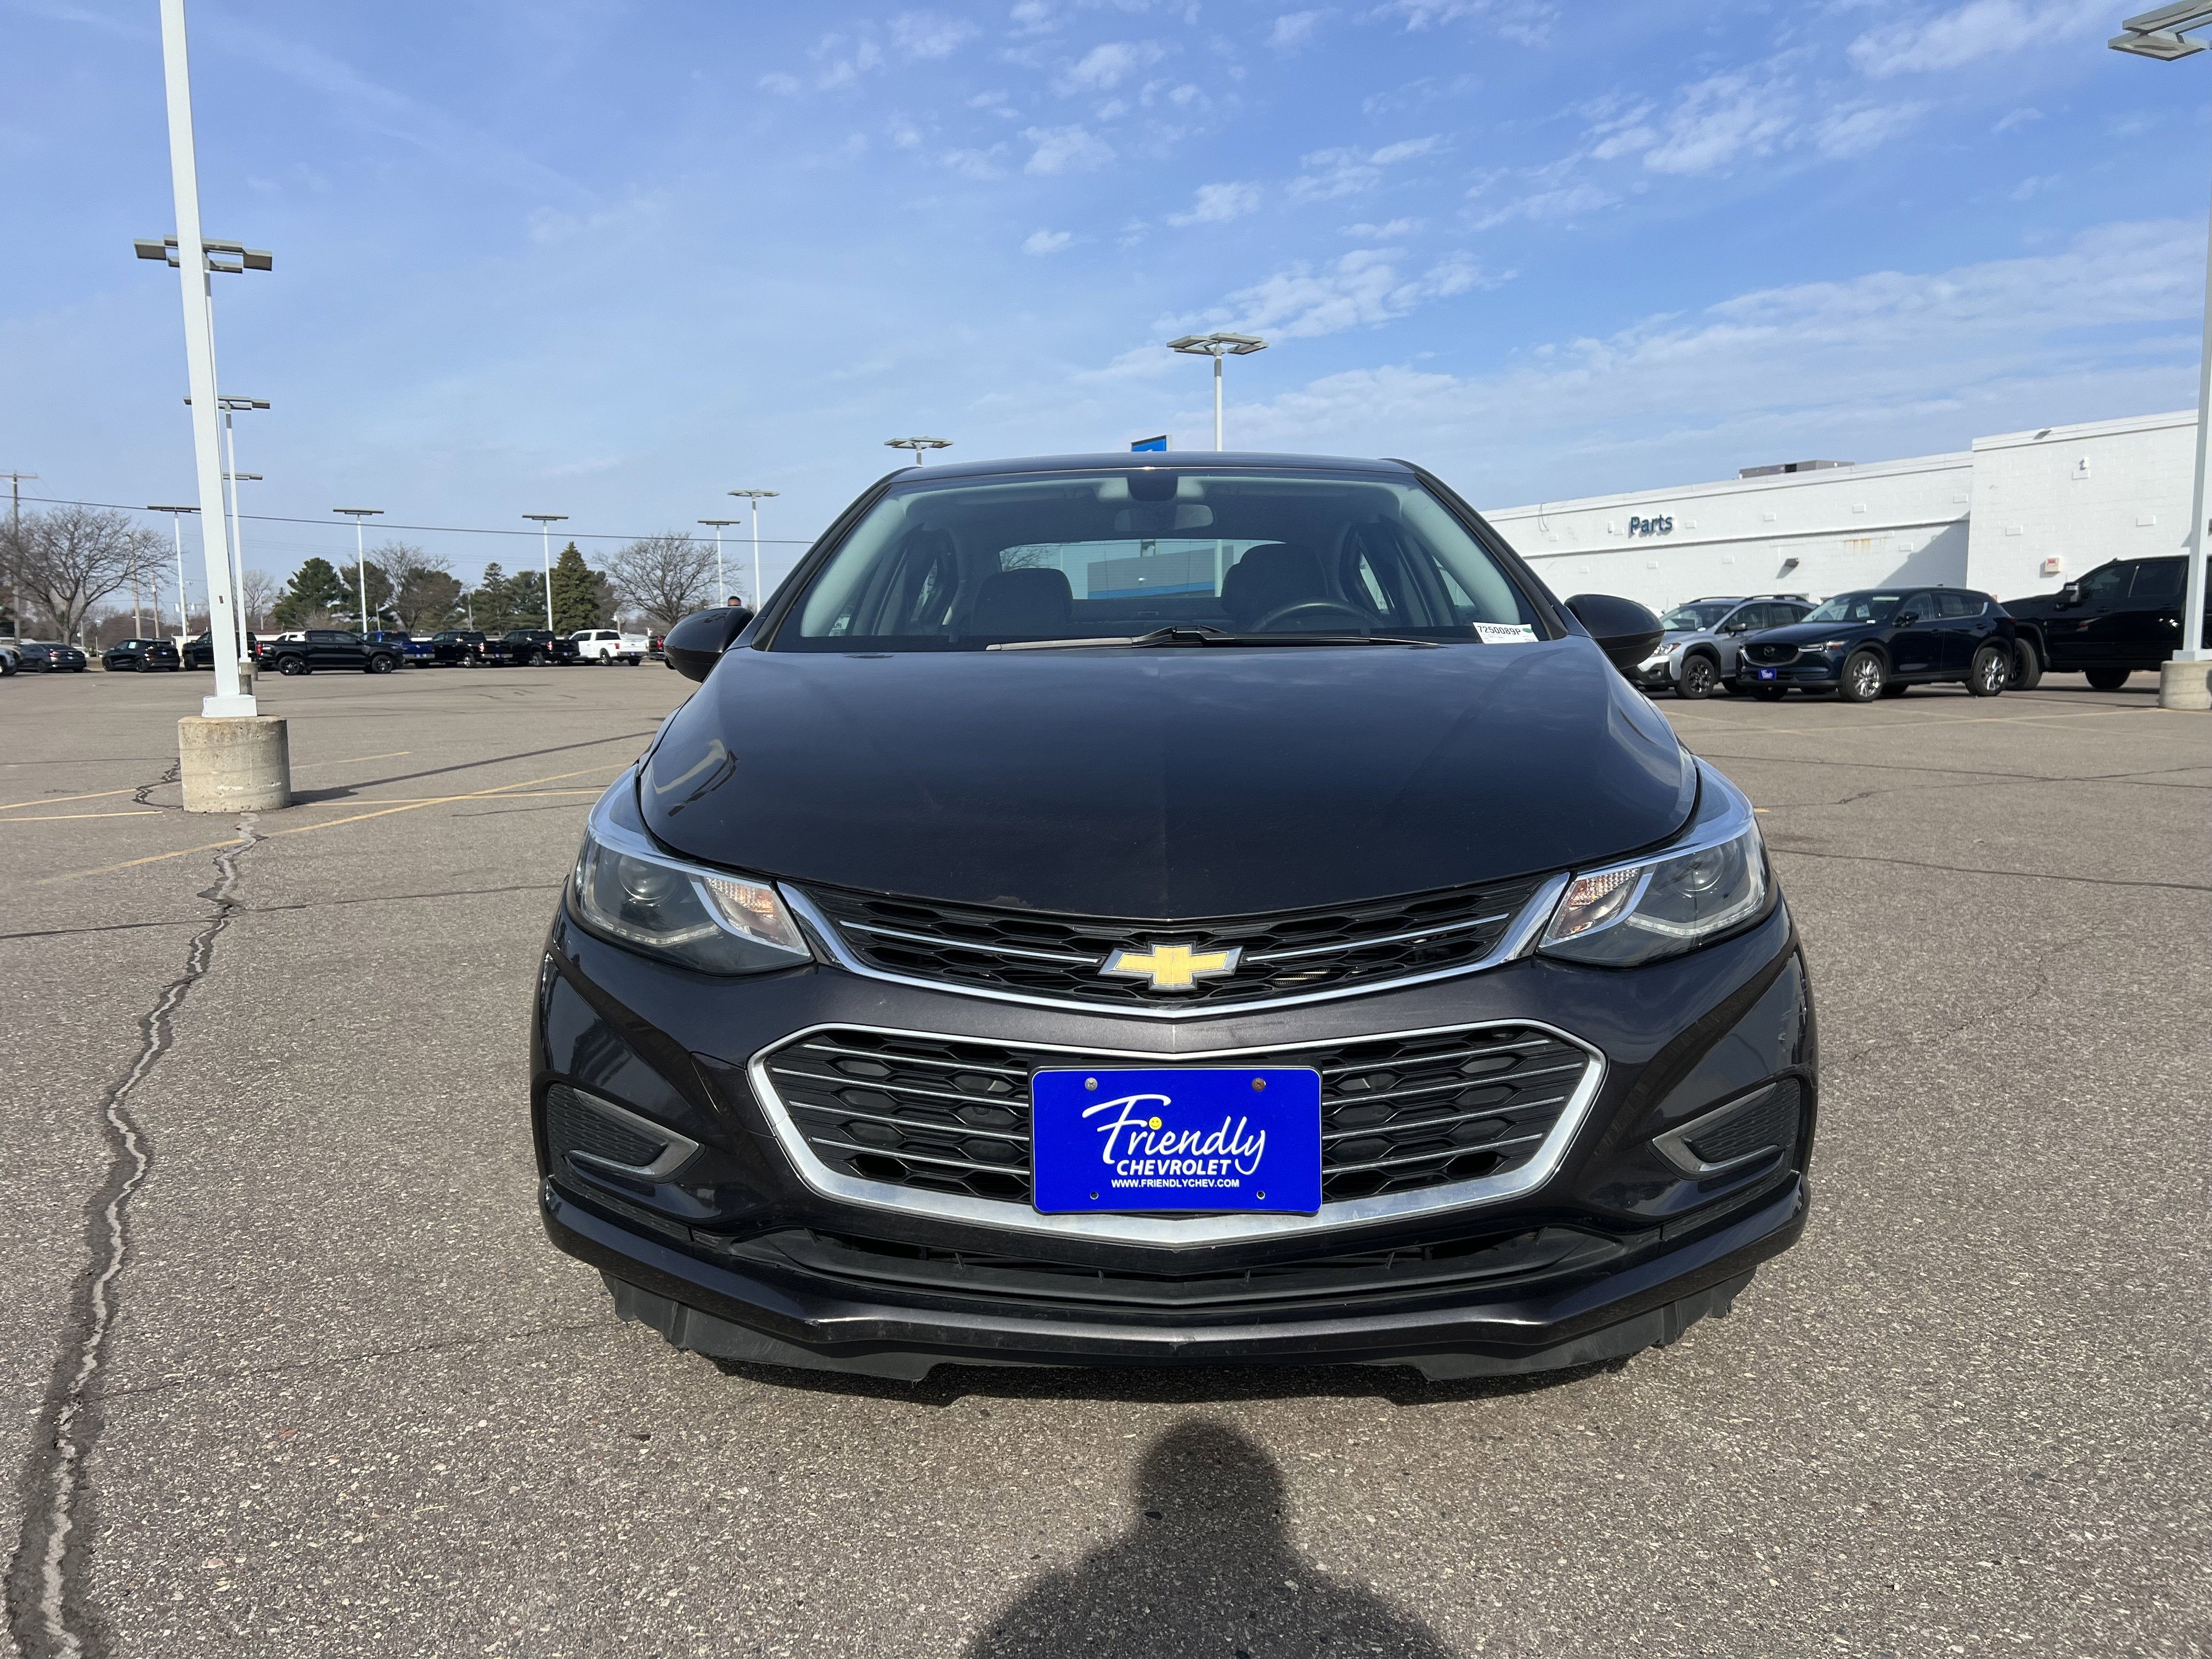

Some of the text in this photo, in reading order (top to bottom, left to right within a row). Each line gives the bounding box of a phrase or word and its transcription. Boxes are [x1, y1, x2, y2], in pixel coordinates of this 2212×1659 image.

[1630, 514, 1673, 534] Parts
[1082, 1094, 1266, 1175] Friendly
[1116, 1159, 1232, 1176] CHEVROLET
[1111, 1178, 1240, 1188] WWW.FRIENDLYCHEV.COM
